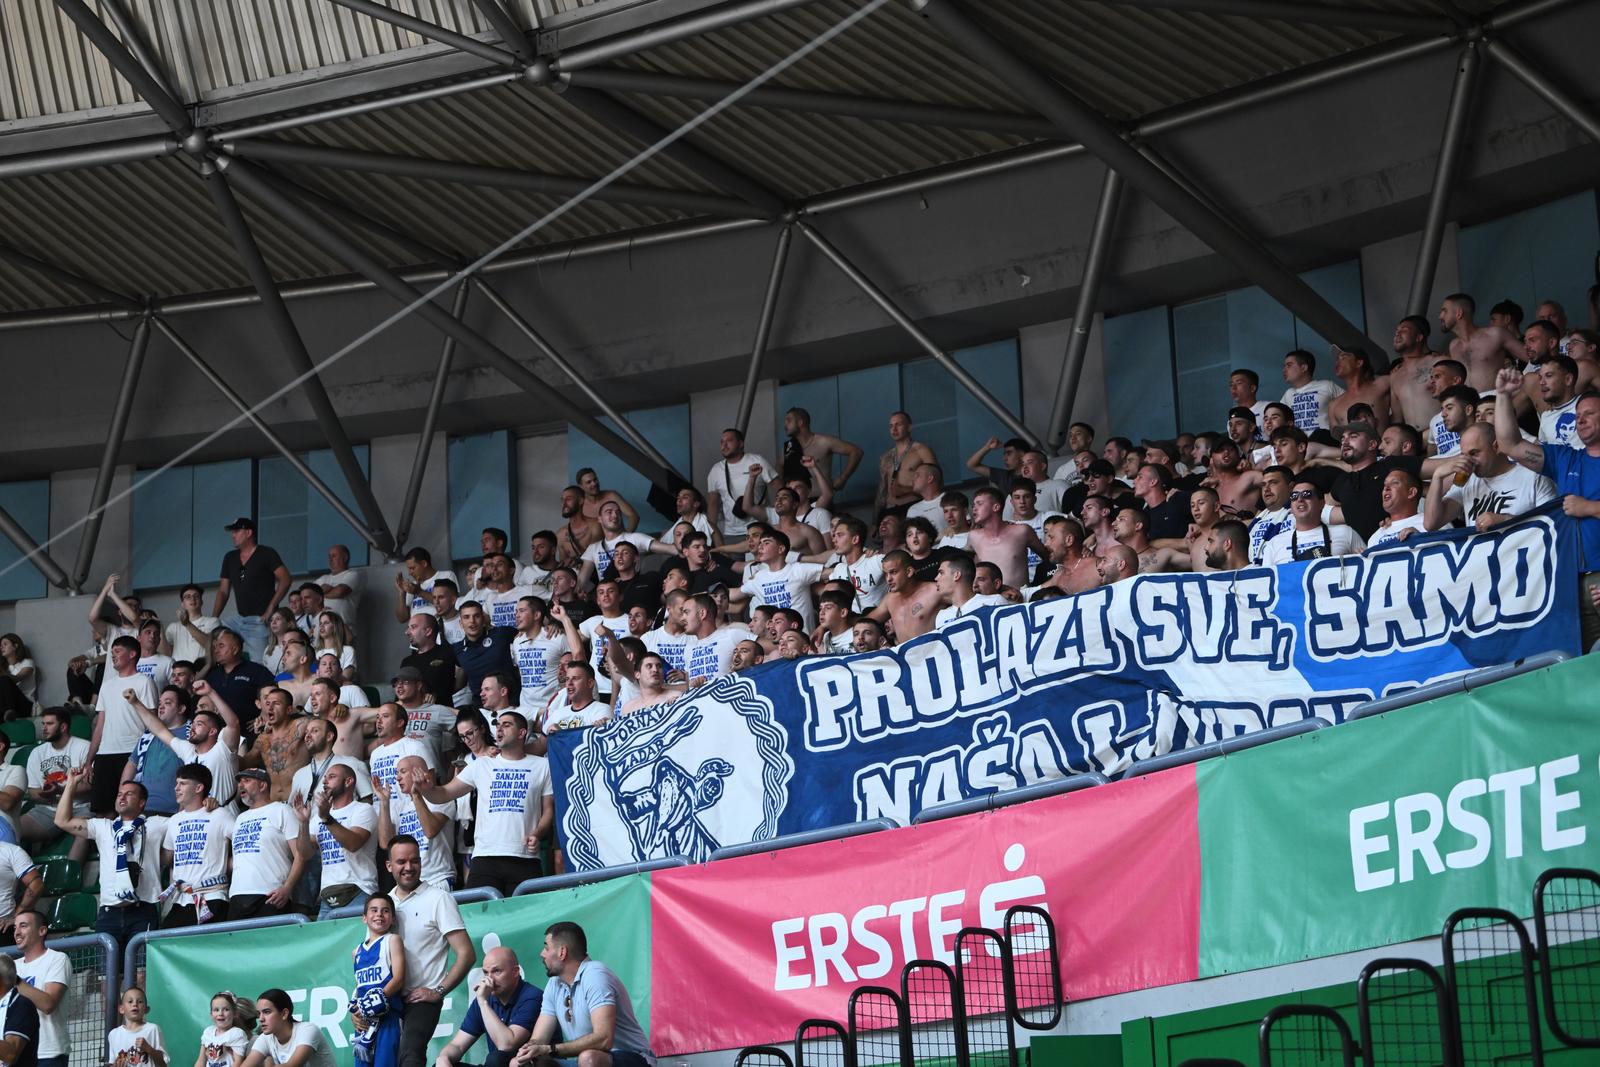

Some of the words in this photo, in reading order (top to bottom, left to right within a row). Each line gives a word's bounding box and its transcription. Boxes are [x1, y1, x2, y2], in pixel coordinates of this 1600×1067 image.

[806, 589, 1115, 742] PROLAZI
[1135, 575, 1293, 669] SVE,
[1312, 524, 1550, 652] SAMO
[659, 647, 685, 656] SANJAM
[705, 664, 719, 674] NOC
[408, 711, 431, 720] DALE
[618, 739, 665, 773] ZADAR
[495, 773, 526, 781] SANJAM
[490, 781, 513, 790] JEDAN
[513, 781, 529, 790] DAN
[490, 790, 511, 799] JEDNU
[512, 790, 526, 799] NOC
[180, 823, 205, 833] SANJAM
[1350, 754, 1587, 893] ERSTE
[193, 832, 208, 841] DAN
[193, 841, 205, 851] NOC
[772, 889, 972, 991] ERSTE
